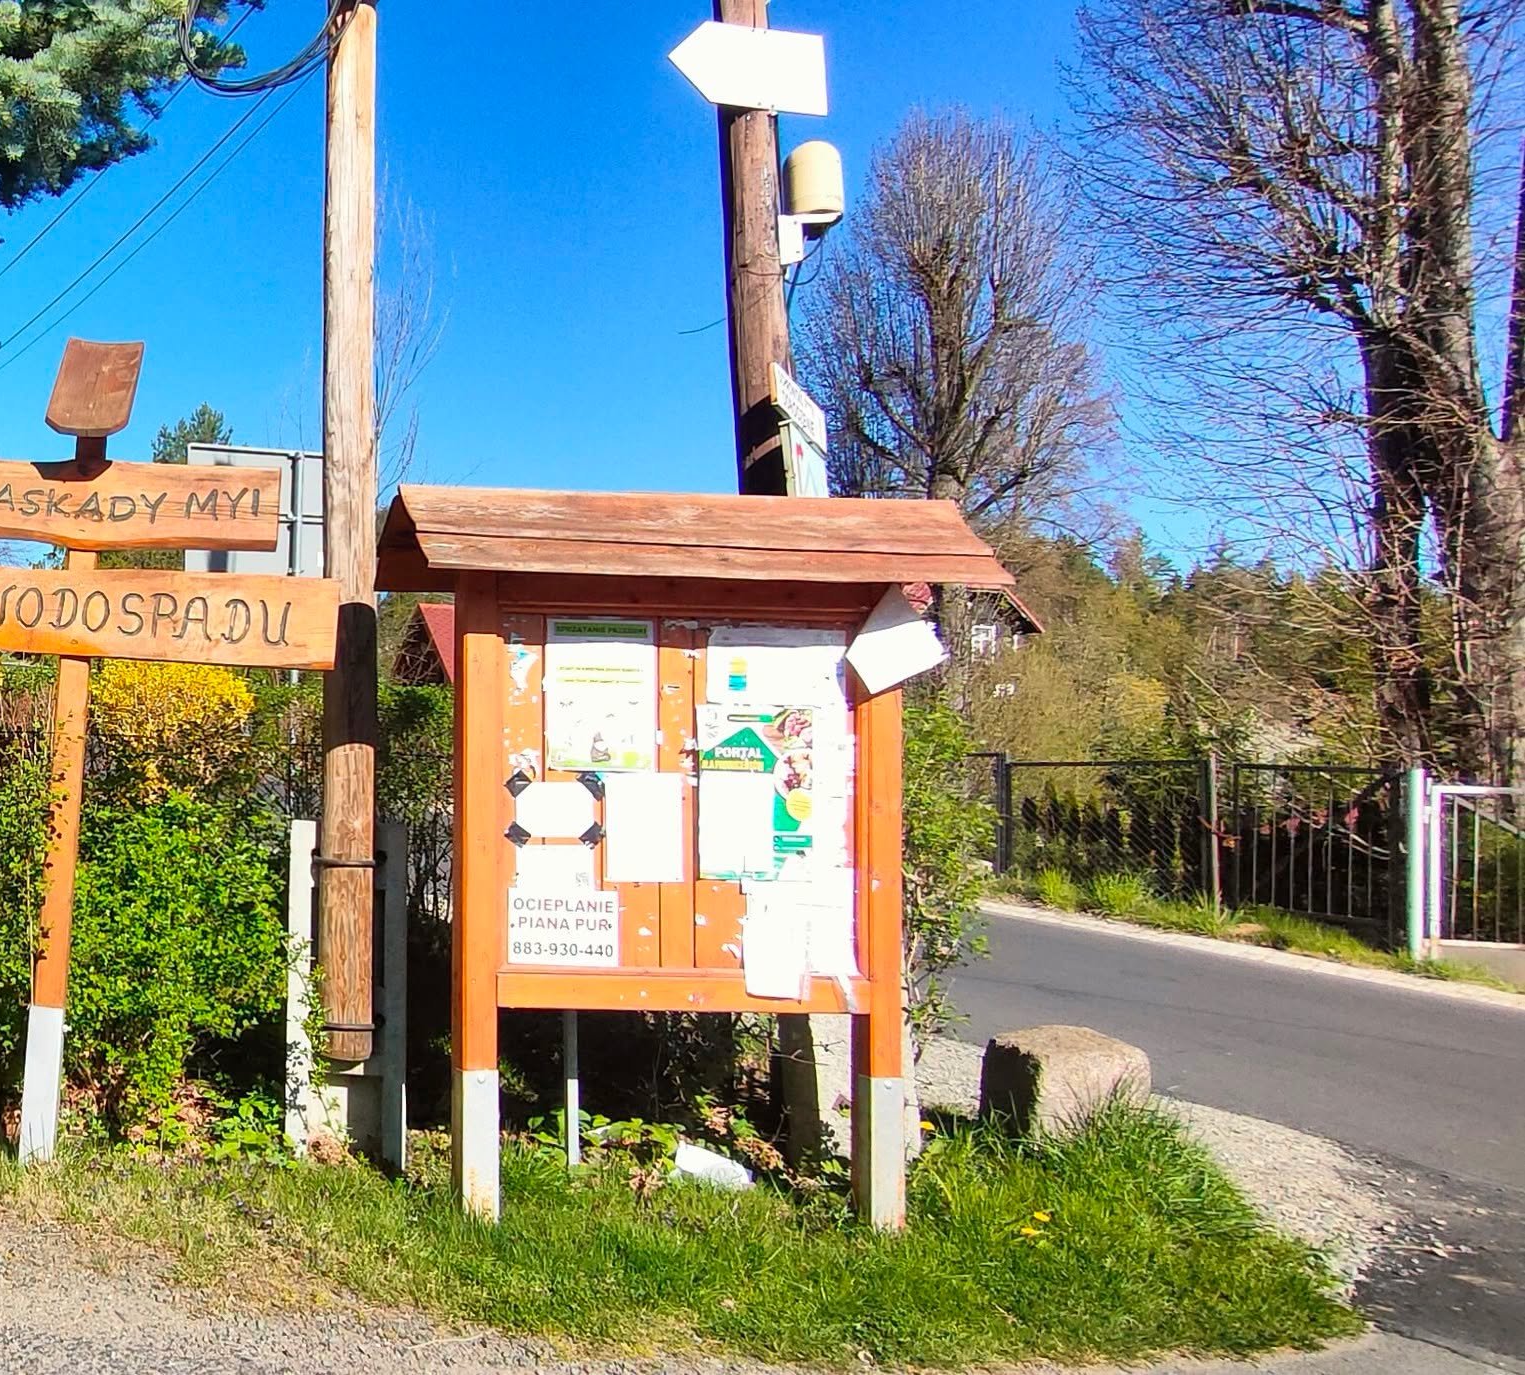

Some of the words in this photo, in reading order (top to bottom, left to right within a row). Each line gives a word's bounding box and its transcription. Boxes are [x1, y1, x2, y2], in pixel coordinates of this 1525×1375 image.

[714, 746, 765, 760] PORTAL
[513, 897, 614, 914] OCIEPLANIE
[518, 916, 570, 931] PIANA
[575, 918, 609, 931] PUR
[512, 941, 614, 958] 883-930-440
